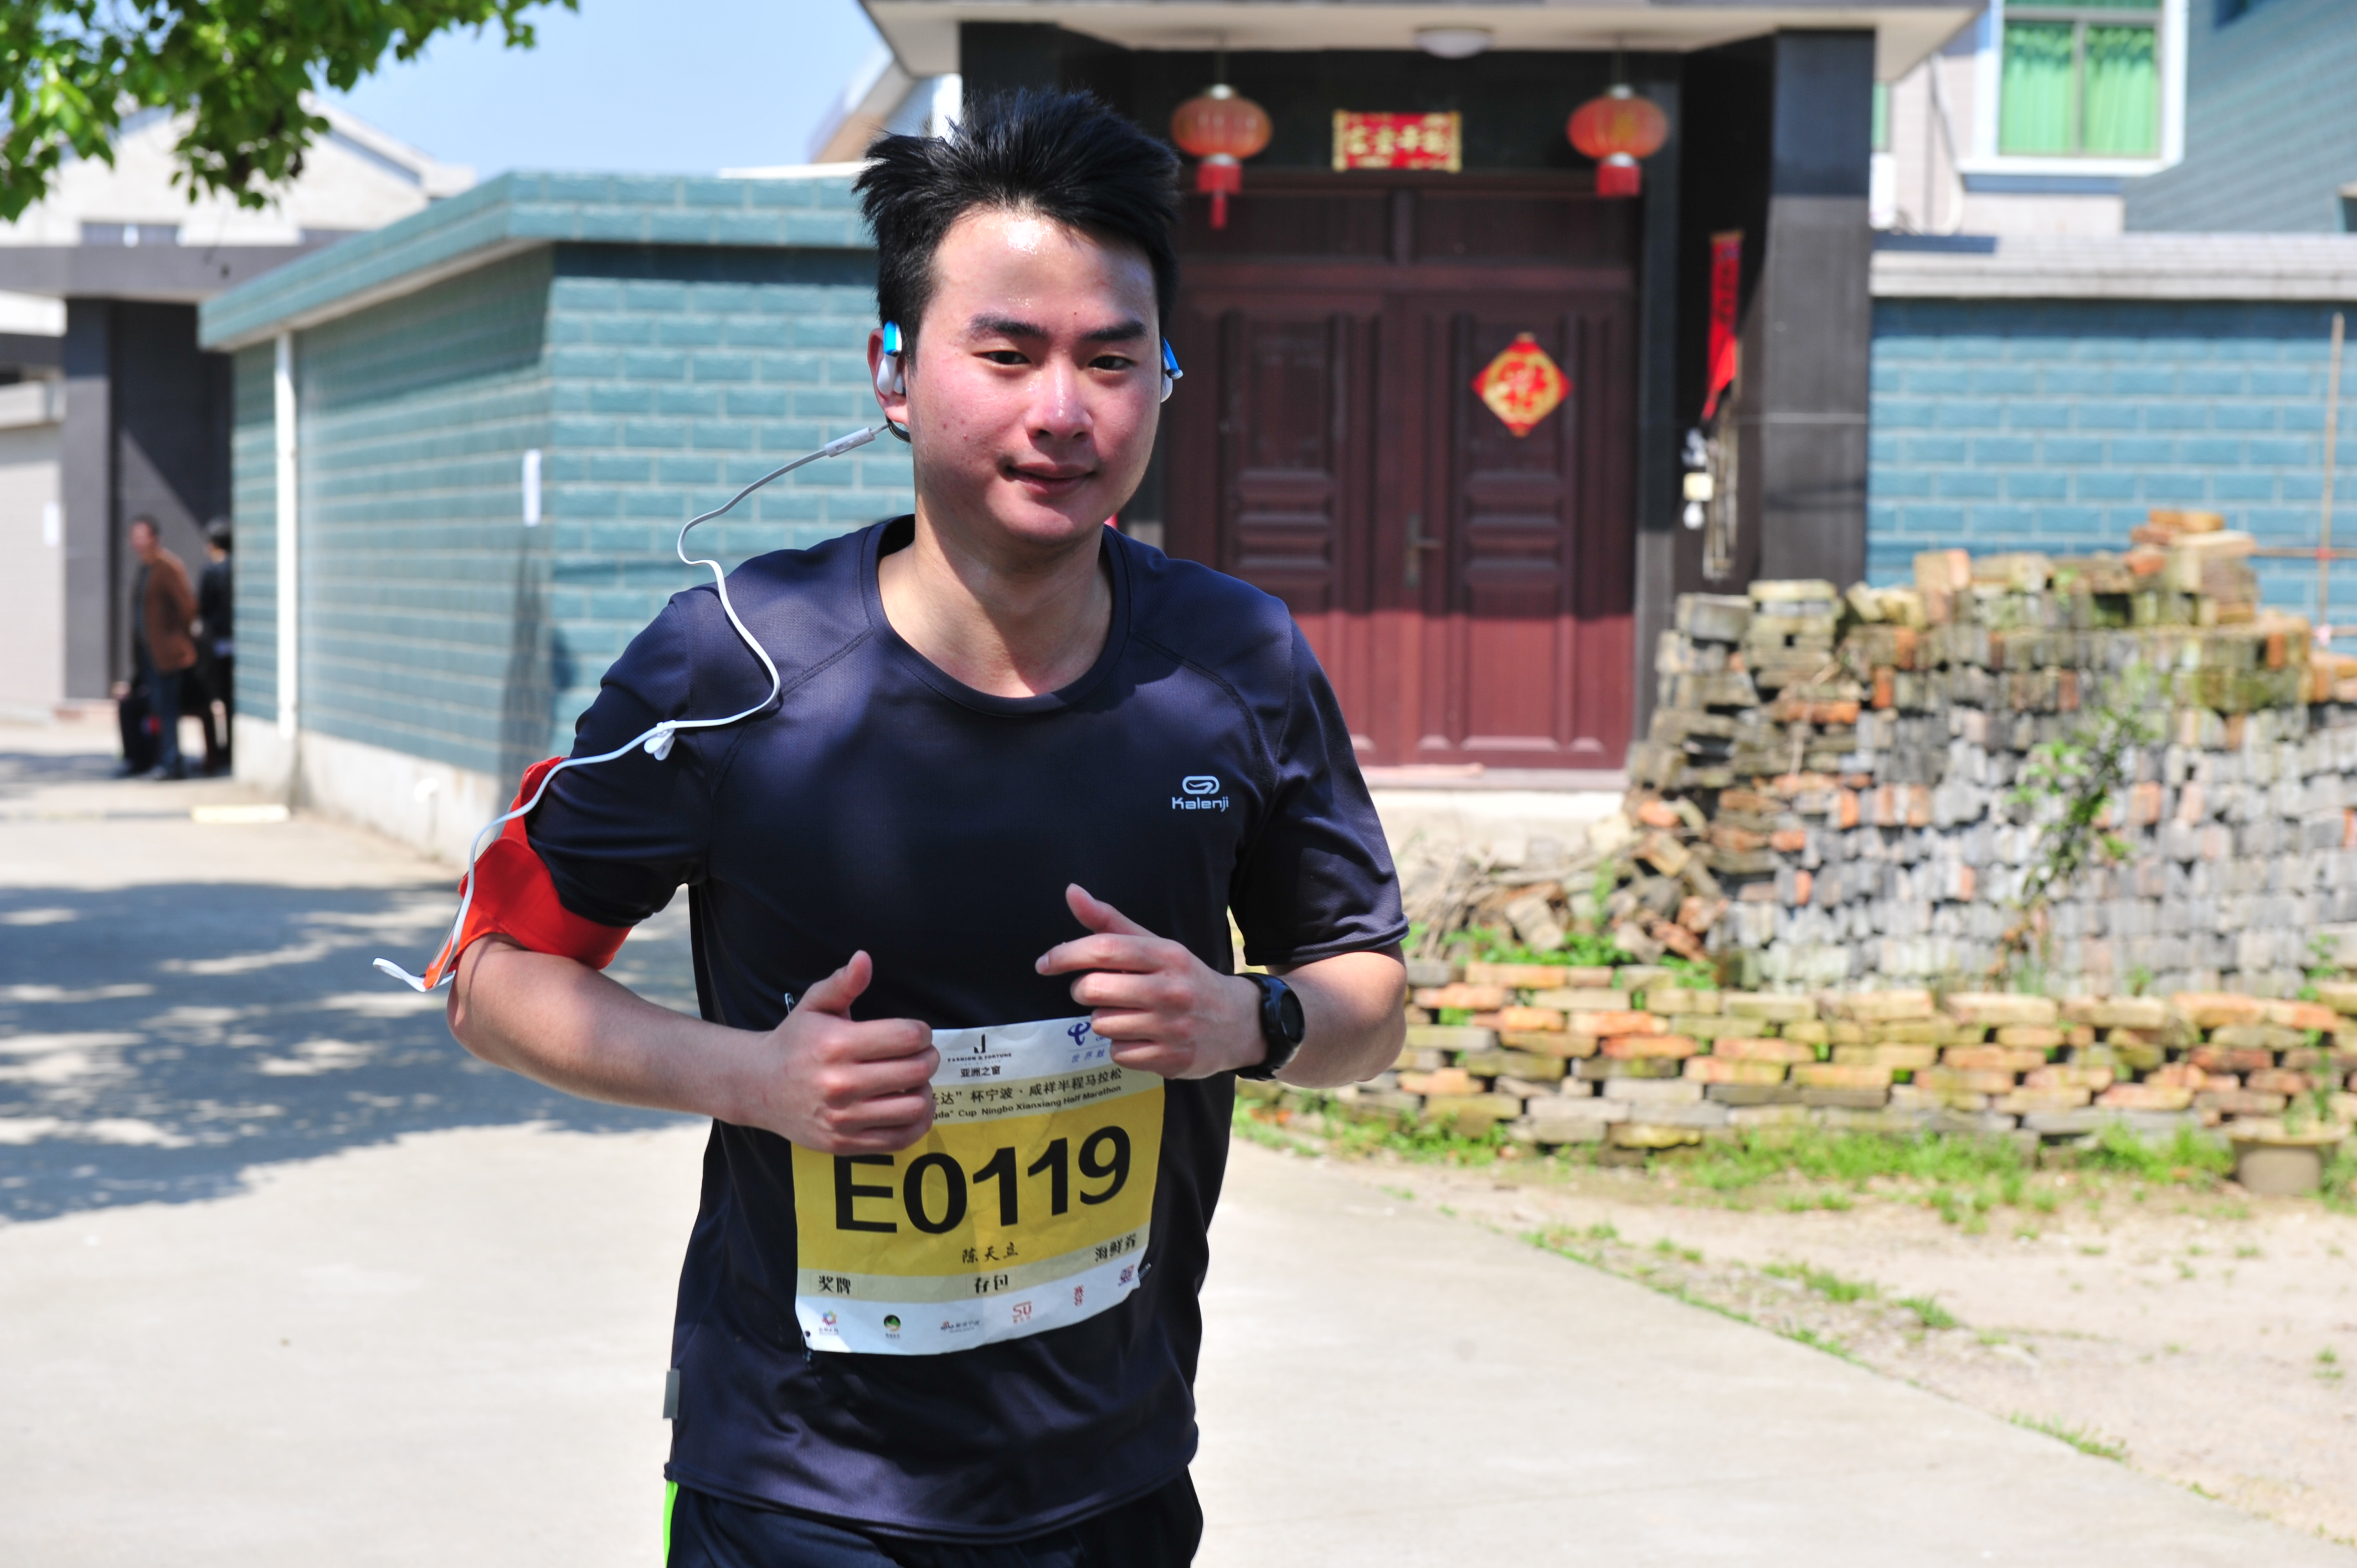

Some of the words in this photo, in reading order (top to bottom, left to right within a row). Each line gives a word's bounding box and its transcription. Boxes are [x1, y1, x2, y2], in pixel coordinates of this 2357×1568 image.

[1172, 796, 1229, 812] Kalenji
[960, 1065, 1001, 1077] 亚洲之窗
[981, 1106, 1014, 1115] Ningbo
[1016, 1100, 1062, 1111] Xianxiang
[1063, 1095, 1080, 1103] Half
[1083, 1086, 1121, 1100] Marathon
[833, 1126, 1131, 1235] E0119
[818, 1275, 851, 1295] 奖牌
